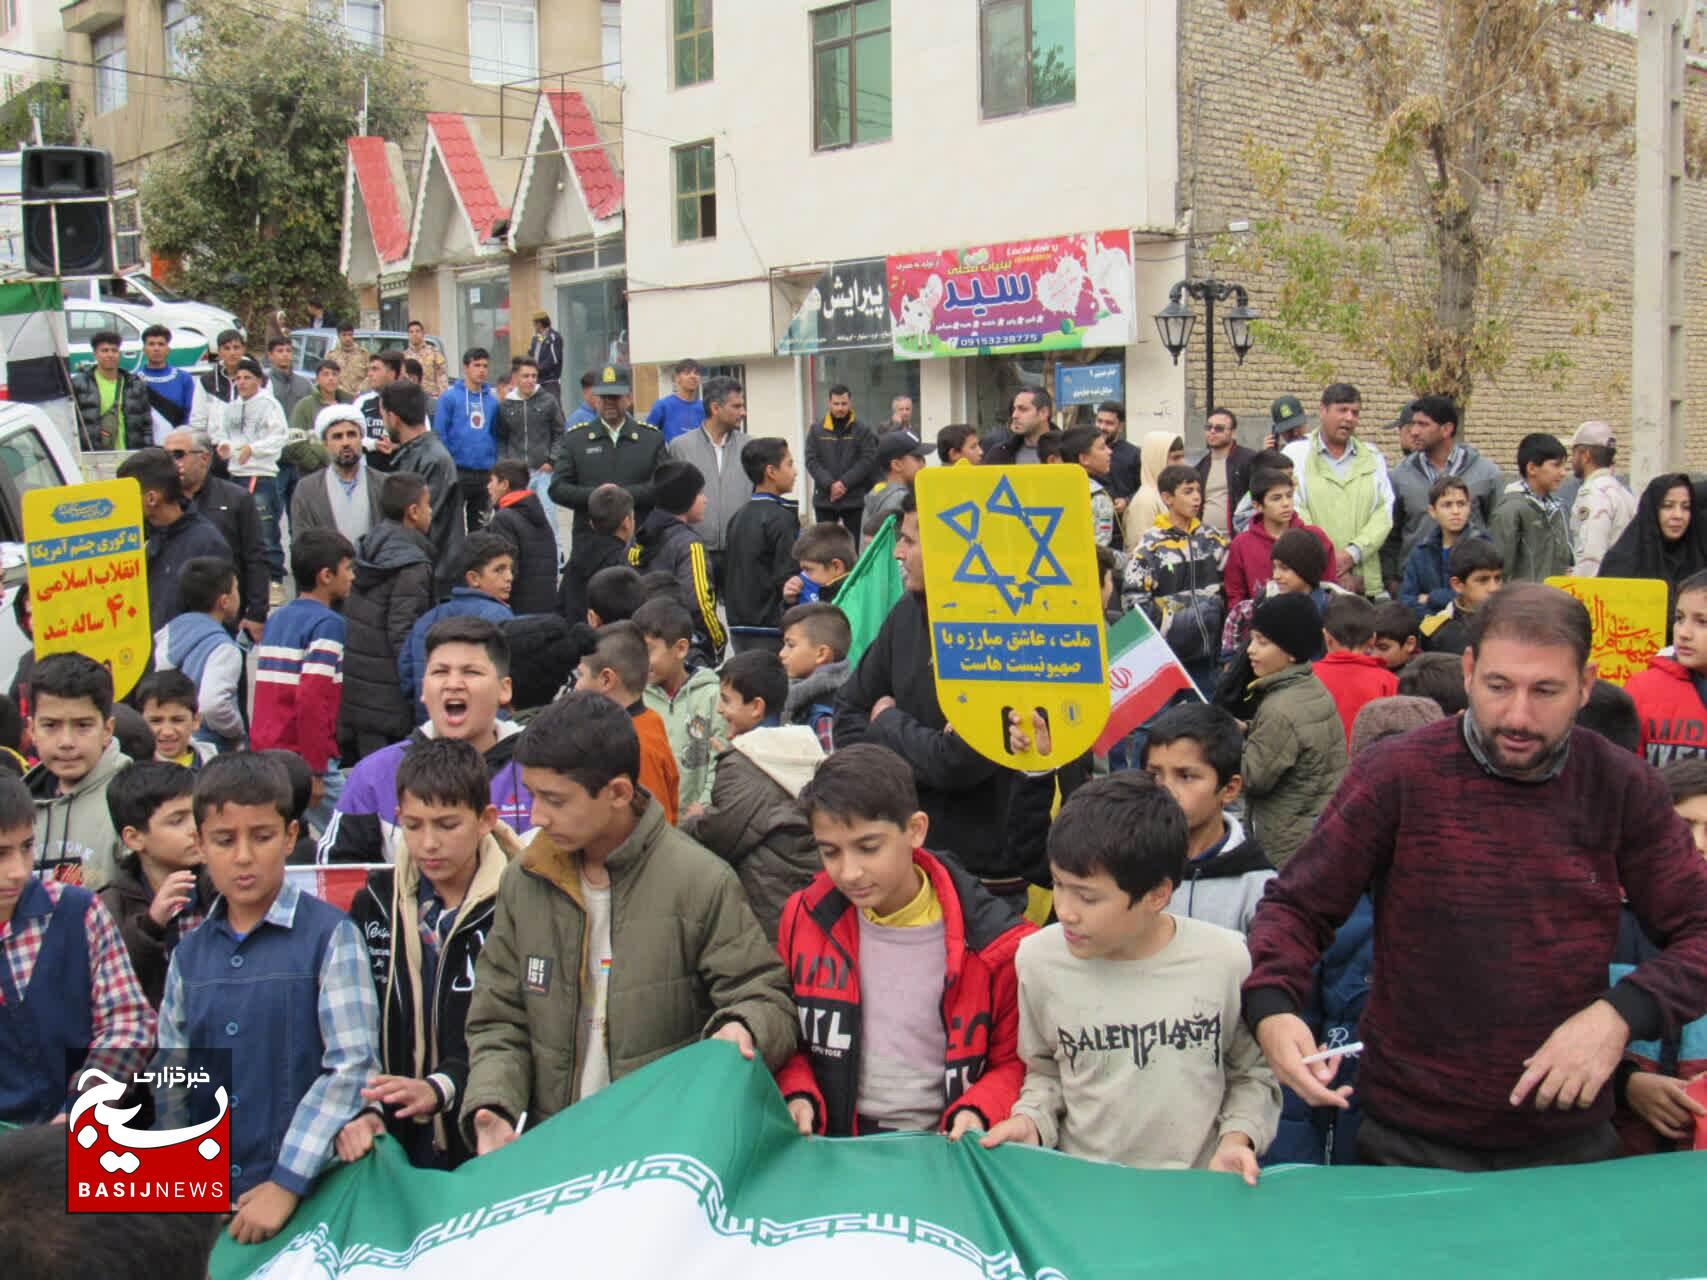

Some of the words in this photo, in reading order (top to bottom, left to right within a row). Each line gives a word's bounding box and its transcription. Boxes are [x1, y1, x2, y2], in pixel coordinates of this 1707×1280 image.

[943, 271, 1033, 316] سید
[37, 568, 94, 602] اسلامی
[95, 559, 140, 589] انقلاب
[44, 618, 69, 641] شد
[71, 612, 104, 634] ساله
[942, 628, 954, 649] با
[957, 629, 1003, 651] مبارزه
[1007, 630, 1046, 651] عاشق
